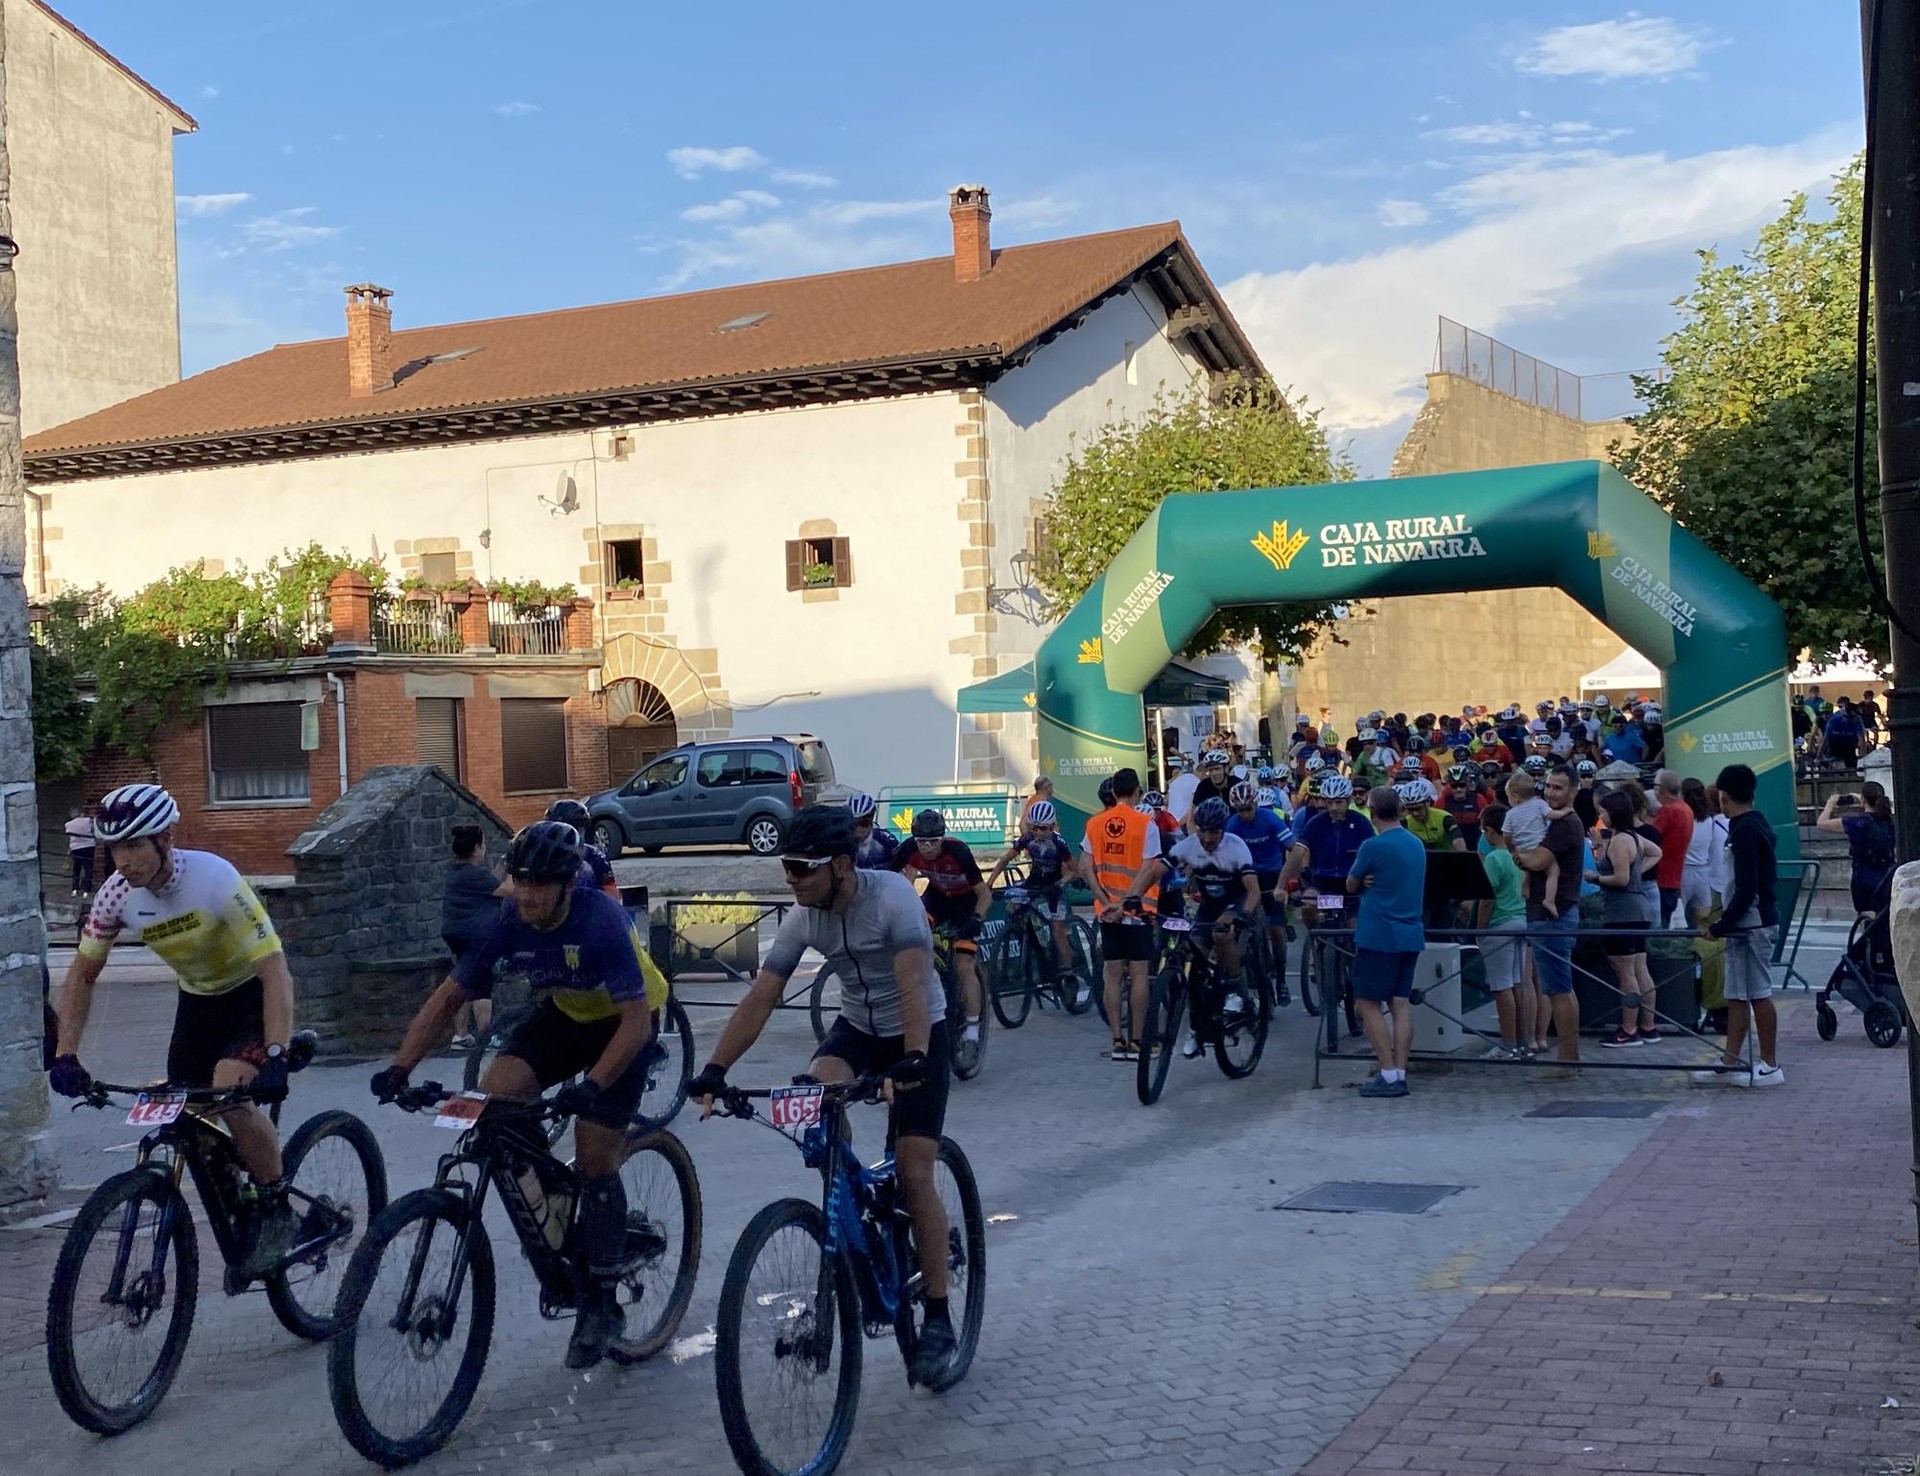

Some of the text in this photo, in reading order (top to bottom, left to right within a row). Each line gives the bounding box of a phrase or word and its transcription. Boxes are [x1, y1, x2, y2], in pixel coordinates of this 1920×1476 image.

[1320, 514, 1473, 545] CAJA RURAL
[1321, 536, 1487, 568] DE NAVARRA
[1621, 556, 1697, 622] CAJA RURAL
[1101, 569, 1161, 635] CAJA RURAL
[1109, 573, 1175, 645] DE NAVARRA
[1610, 565, 1694, 637] DE NAVARRA
[1702, 729, 1769, 743] CAJA RURAL
[1703, 739, 1773, 753] DE NAVARRA
[1060, 756, 1116, 767] CAJA RURAL
[1060, 765, 1119, 776] DE NAVARRA
[956, 807, 997, 819] RURAL
[945, 820, 1001, 832] NAVARRA
[138, 1103, 180, 1121] 145
[775, 1097, 816, 1123] 165
